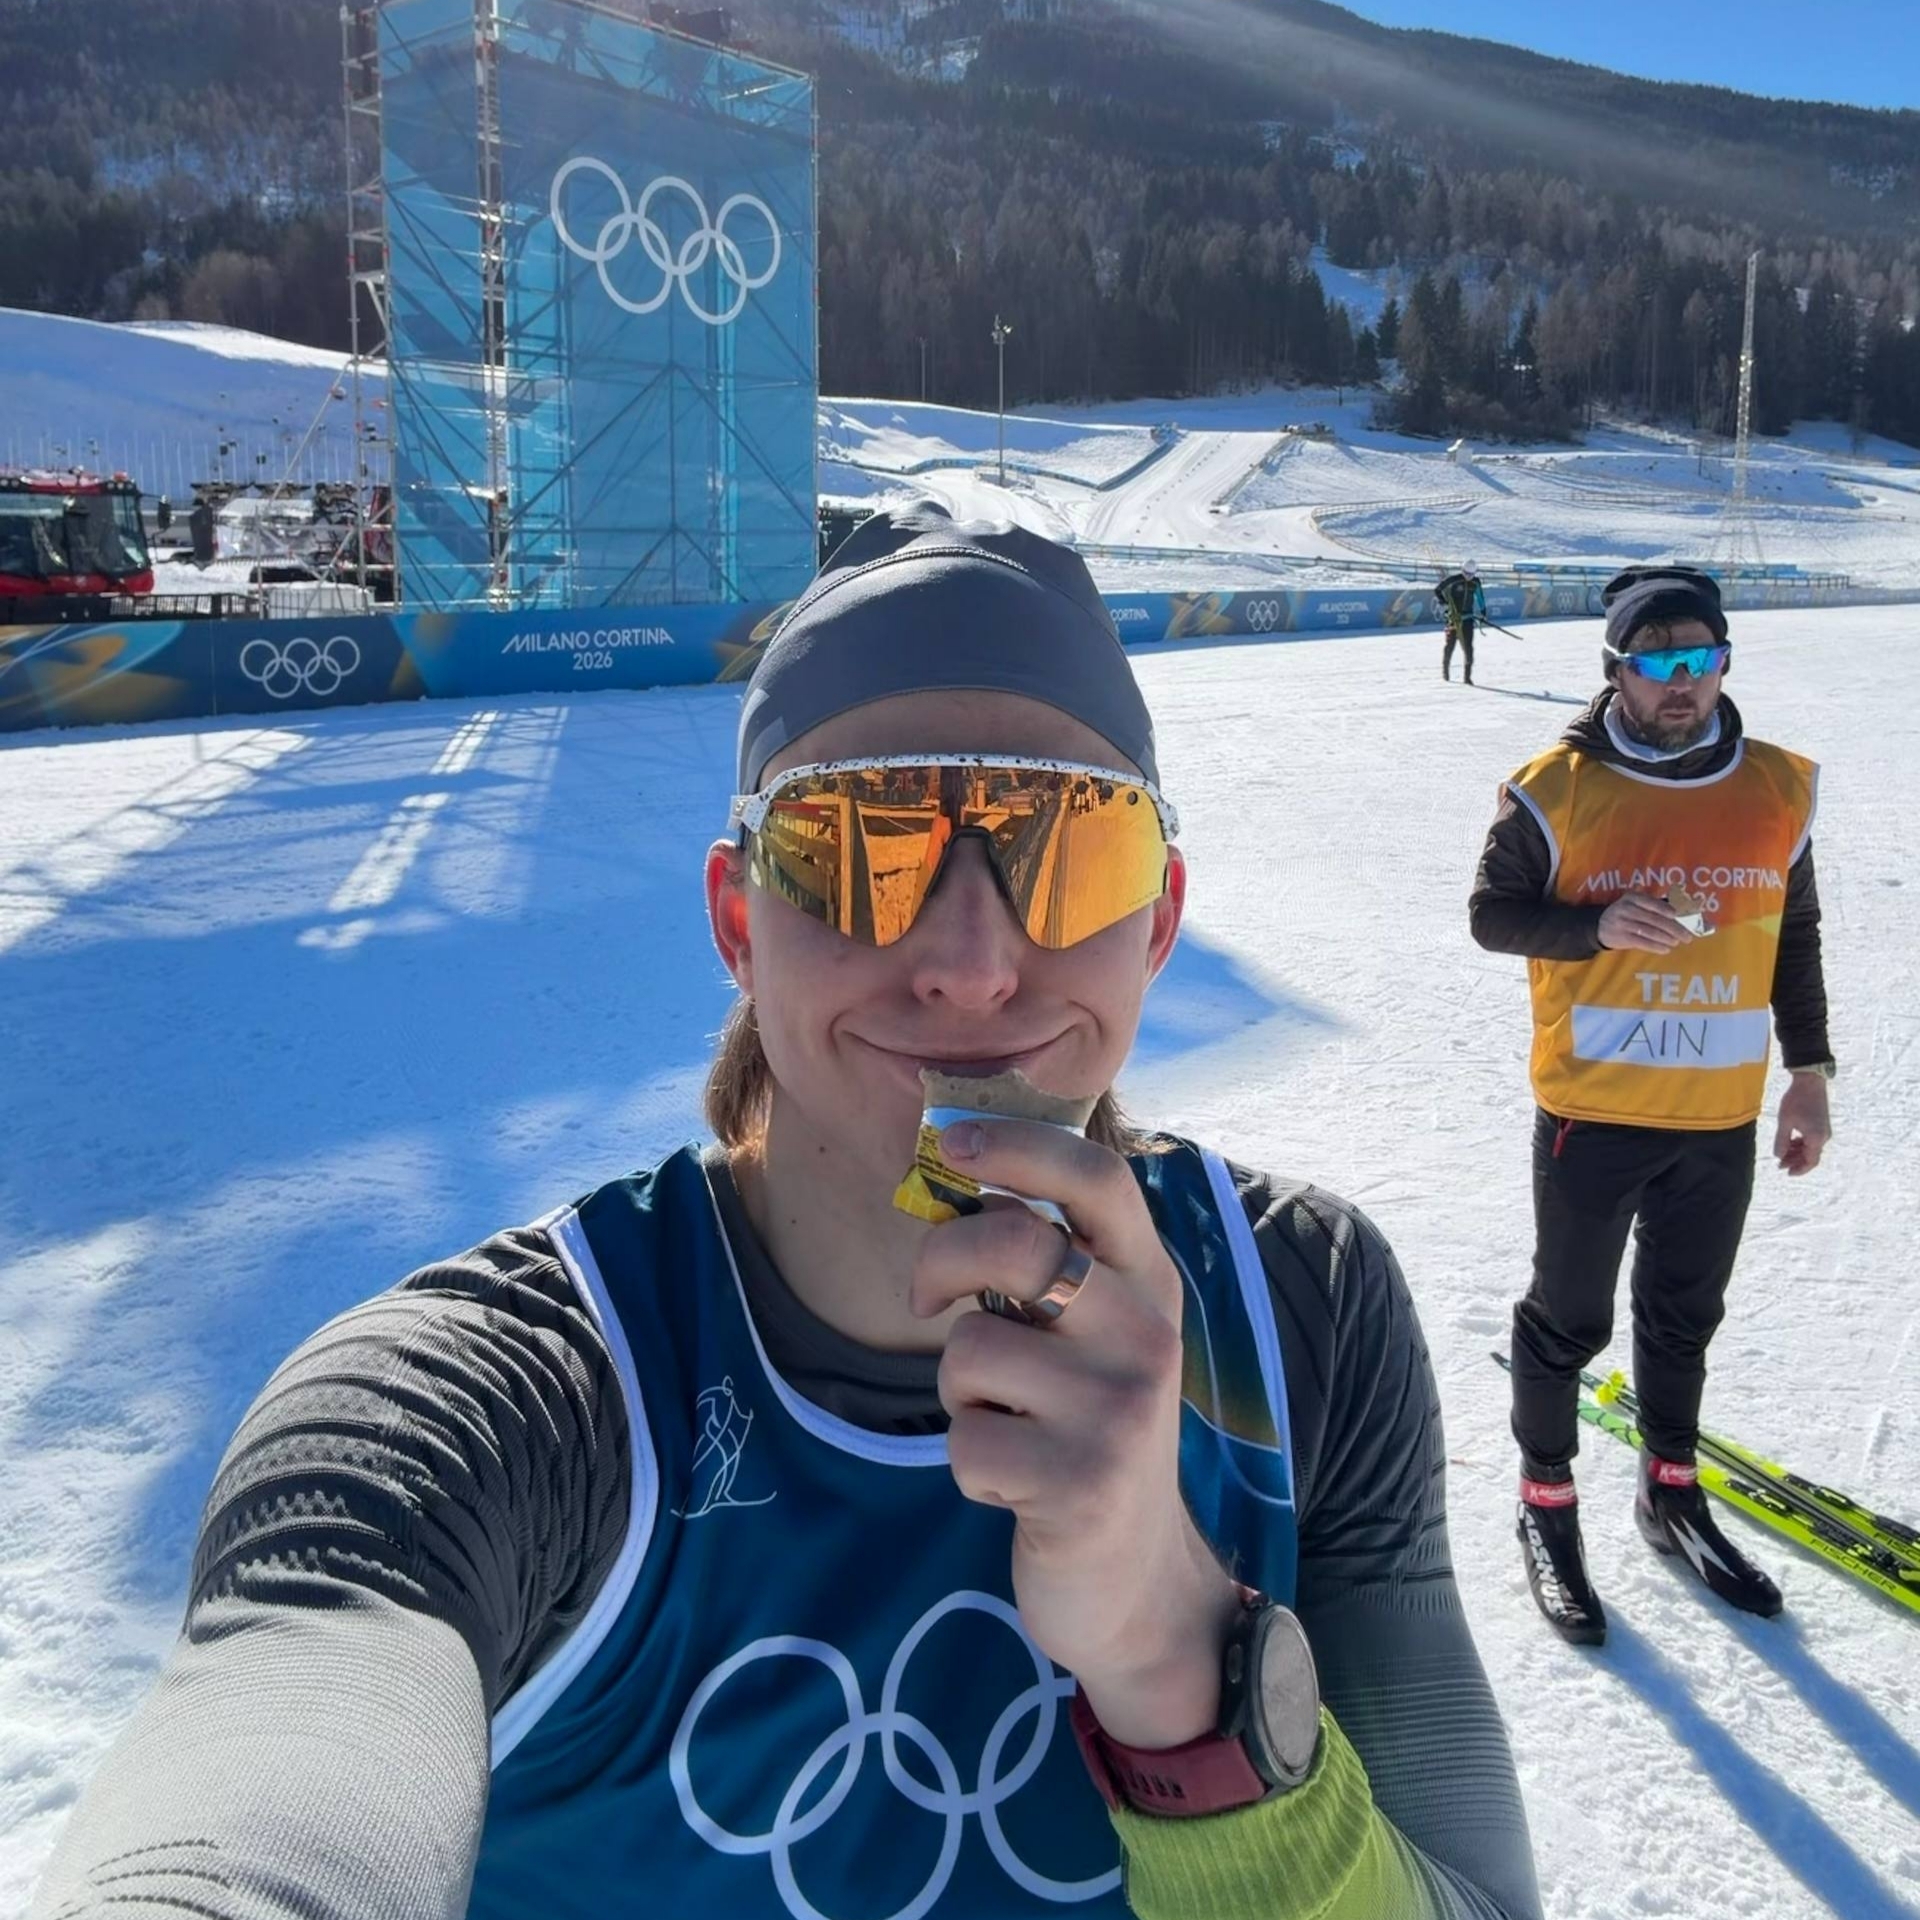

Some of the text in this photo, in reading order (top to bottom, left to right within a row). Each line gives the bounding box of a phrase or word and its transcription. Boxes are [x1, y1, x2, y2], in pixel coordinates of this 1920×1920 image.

[502, 627, 675, 654] MILANO CORTINA
[572, 651, 613, 670] 2026
[1577, 866, 1686, 893] MILANO
[1635, 972, 1738, 1005] TEAM
[1619, 1019, 1707, 1059] AIN
[1873, 1532, 1920, 1564] FISC
[1810, 1538, 1897, 1593] FISCHER
